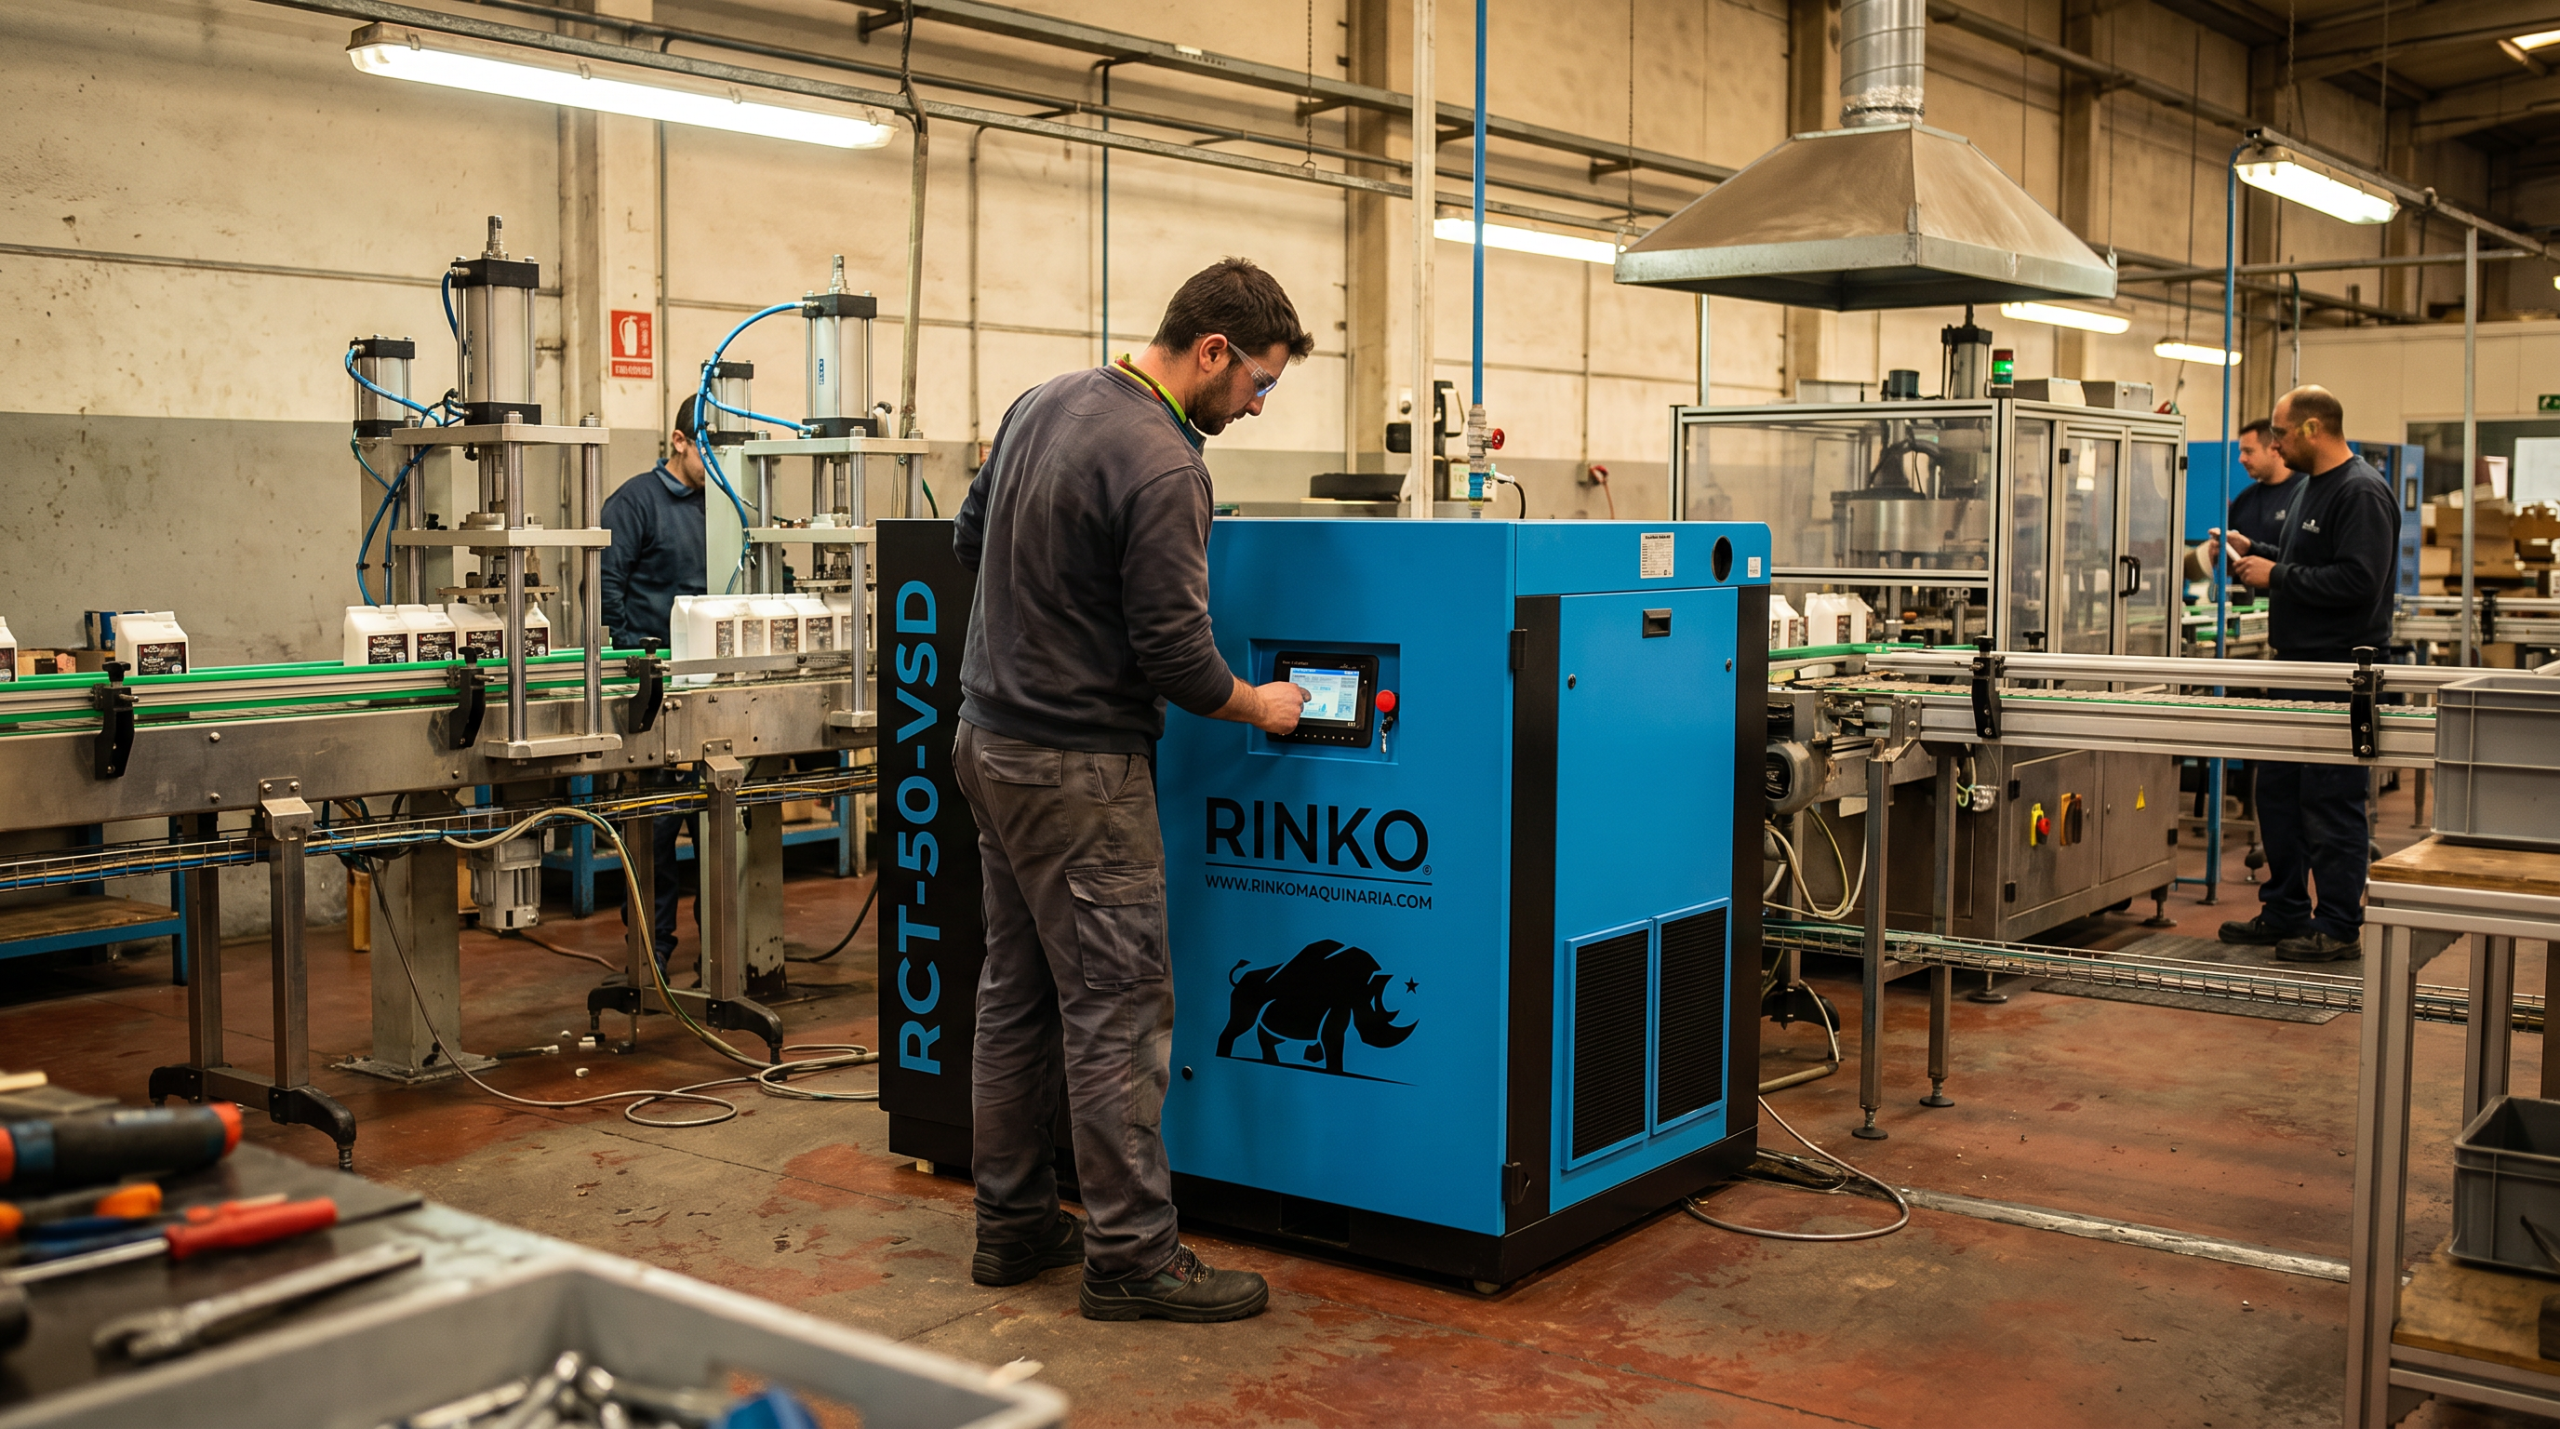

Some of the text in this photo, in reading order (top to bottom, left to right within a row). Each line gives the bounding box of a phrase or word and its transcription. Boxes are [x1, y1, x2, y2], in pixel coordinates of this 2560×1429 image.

[895, 580, 941, 1075] RCT-50-VSD
[1205, 796, 1429, 872] RINKO
[1205, 874, 1432, 910] WWW.RINKOMAQUINARIA.COM
